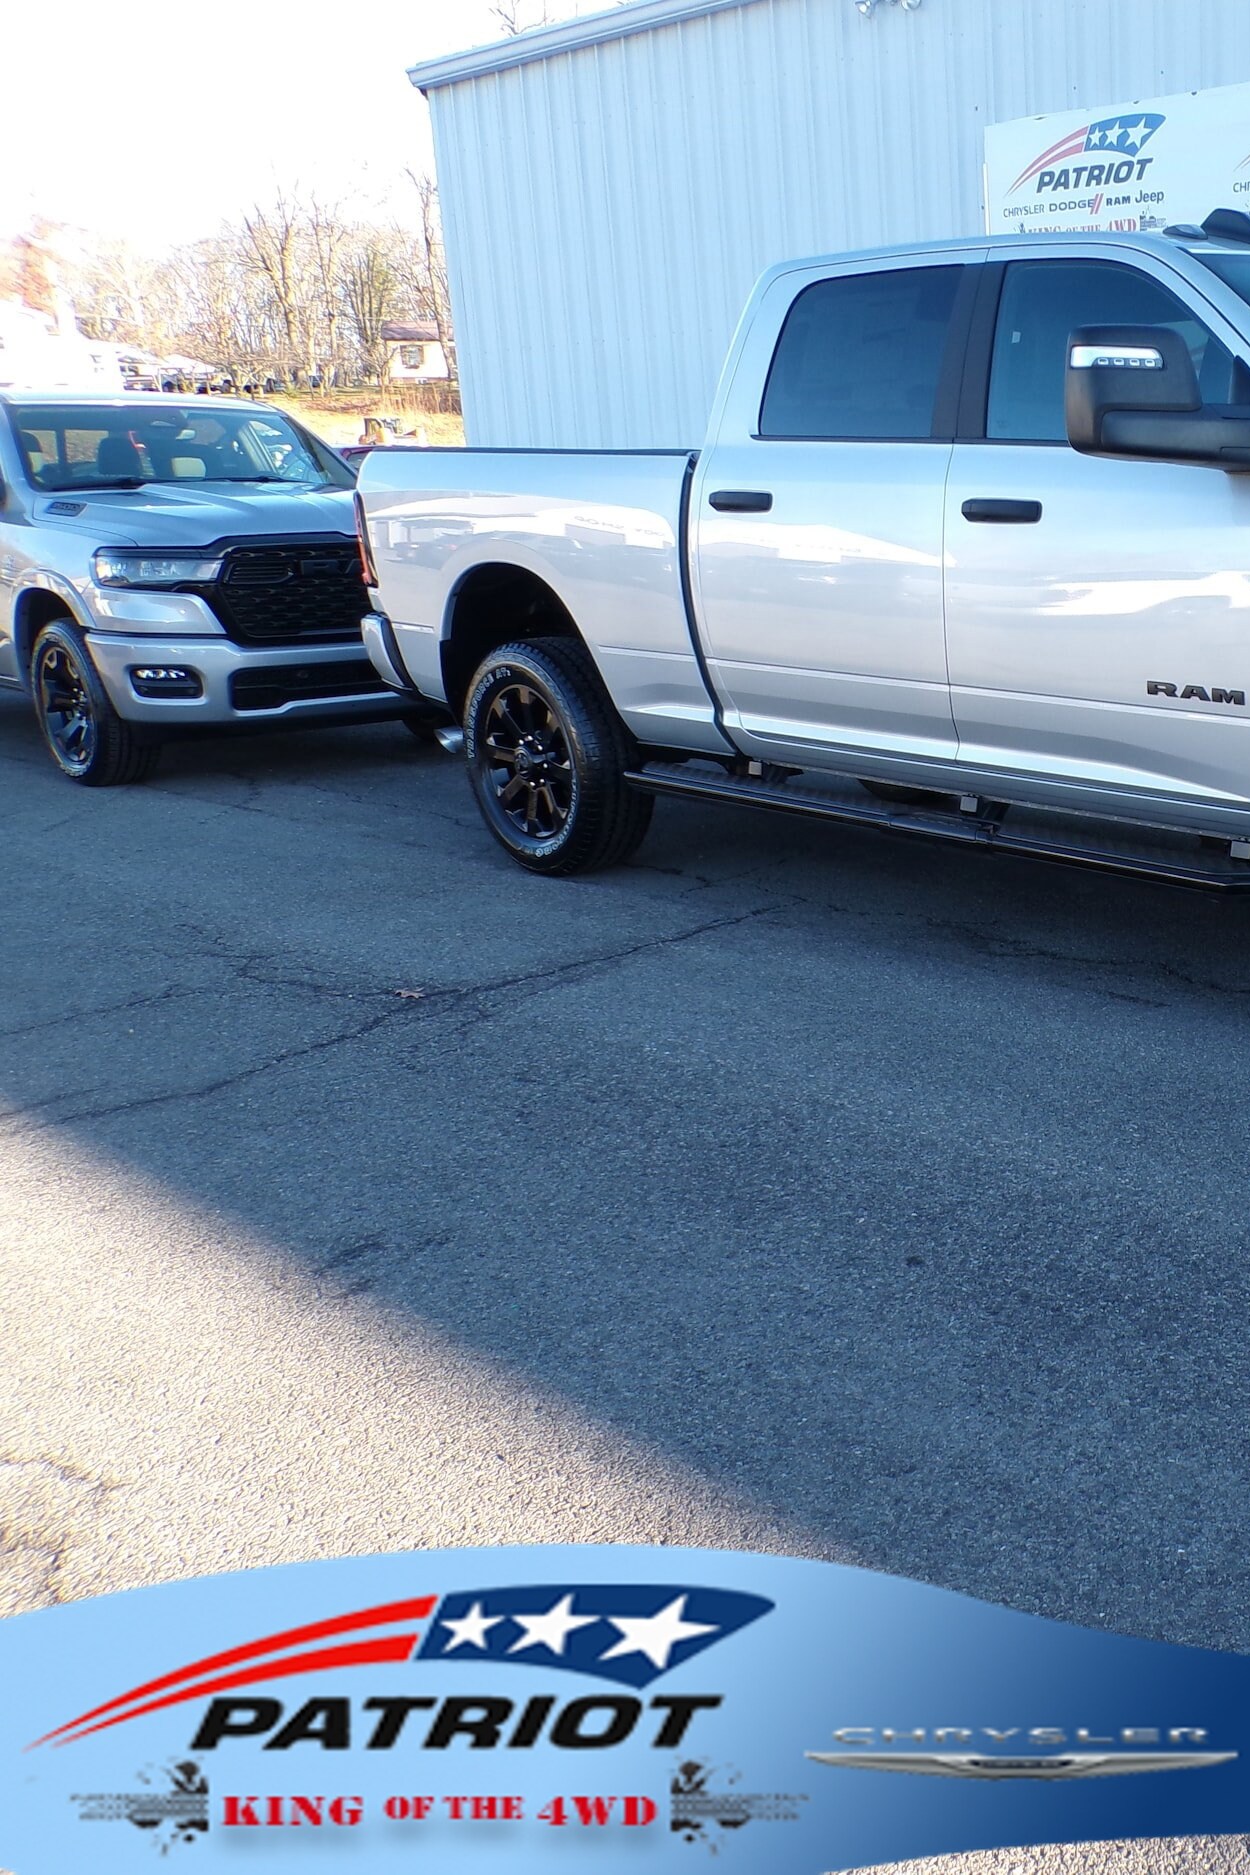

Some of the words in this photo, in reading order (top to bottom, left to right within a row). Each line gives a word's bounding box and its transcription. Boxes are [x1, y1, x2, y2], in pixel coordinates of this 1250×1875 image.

[1036, 157, 1153, 194] PATRIOT
[1003, 203, 1045, 218] CHRYSLER
[1049, 198, 1094, 212] DODGE
[1106, 195, 1131, 207] RAM
[1135, 189, 1164, 205] Jeep
[1146, 680, 1246, 706] RAM
